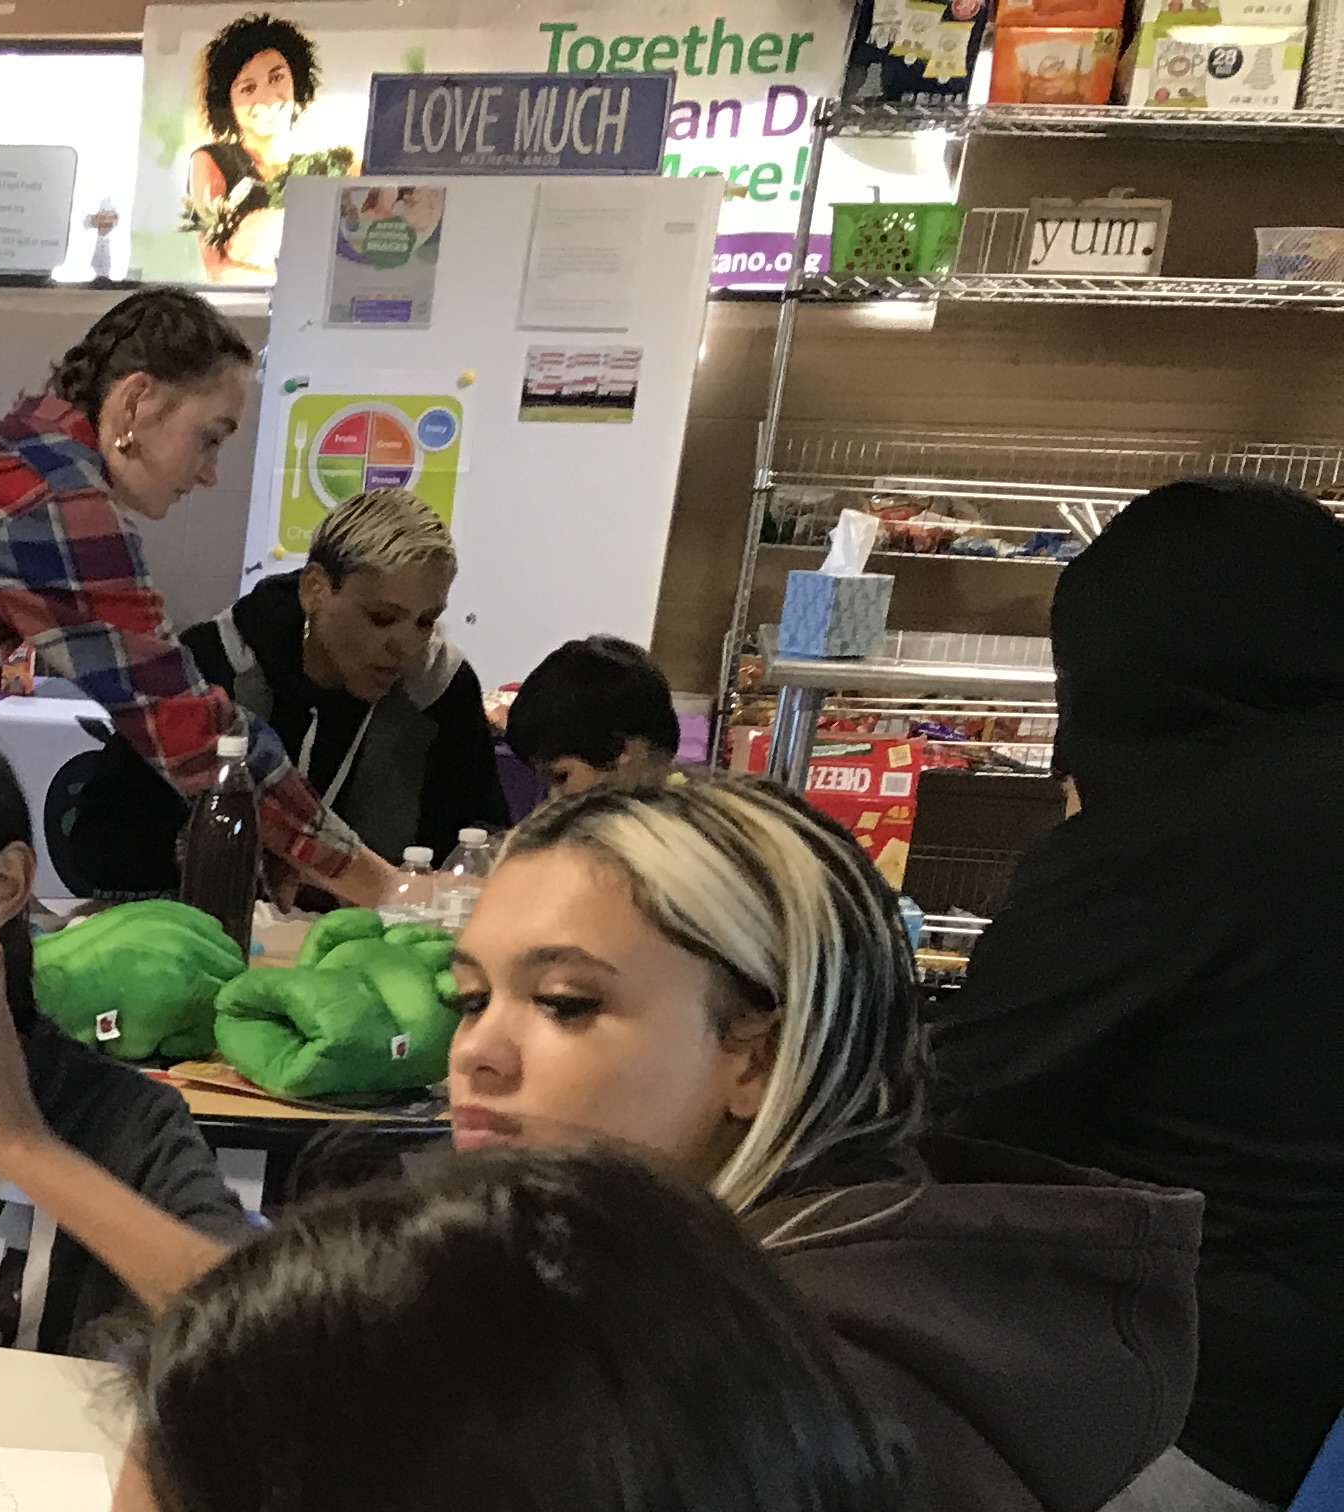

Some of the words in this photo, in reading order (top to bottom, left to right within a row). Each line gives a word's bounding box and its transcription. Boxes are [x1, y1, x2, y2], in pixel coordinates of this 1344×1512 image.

[539, 17, 814, 75] Together
[402, 86, 503, 154] LOVE
[513, 86, 631, 155] MUCH
[667, 98, 743, 141] an
[763, 84, 809, 137] D
[1032, 217, 1153, 265] yum.
